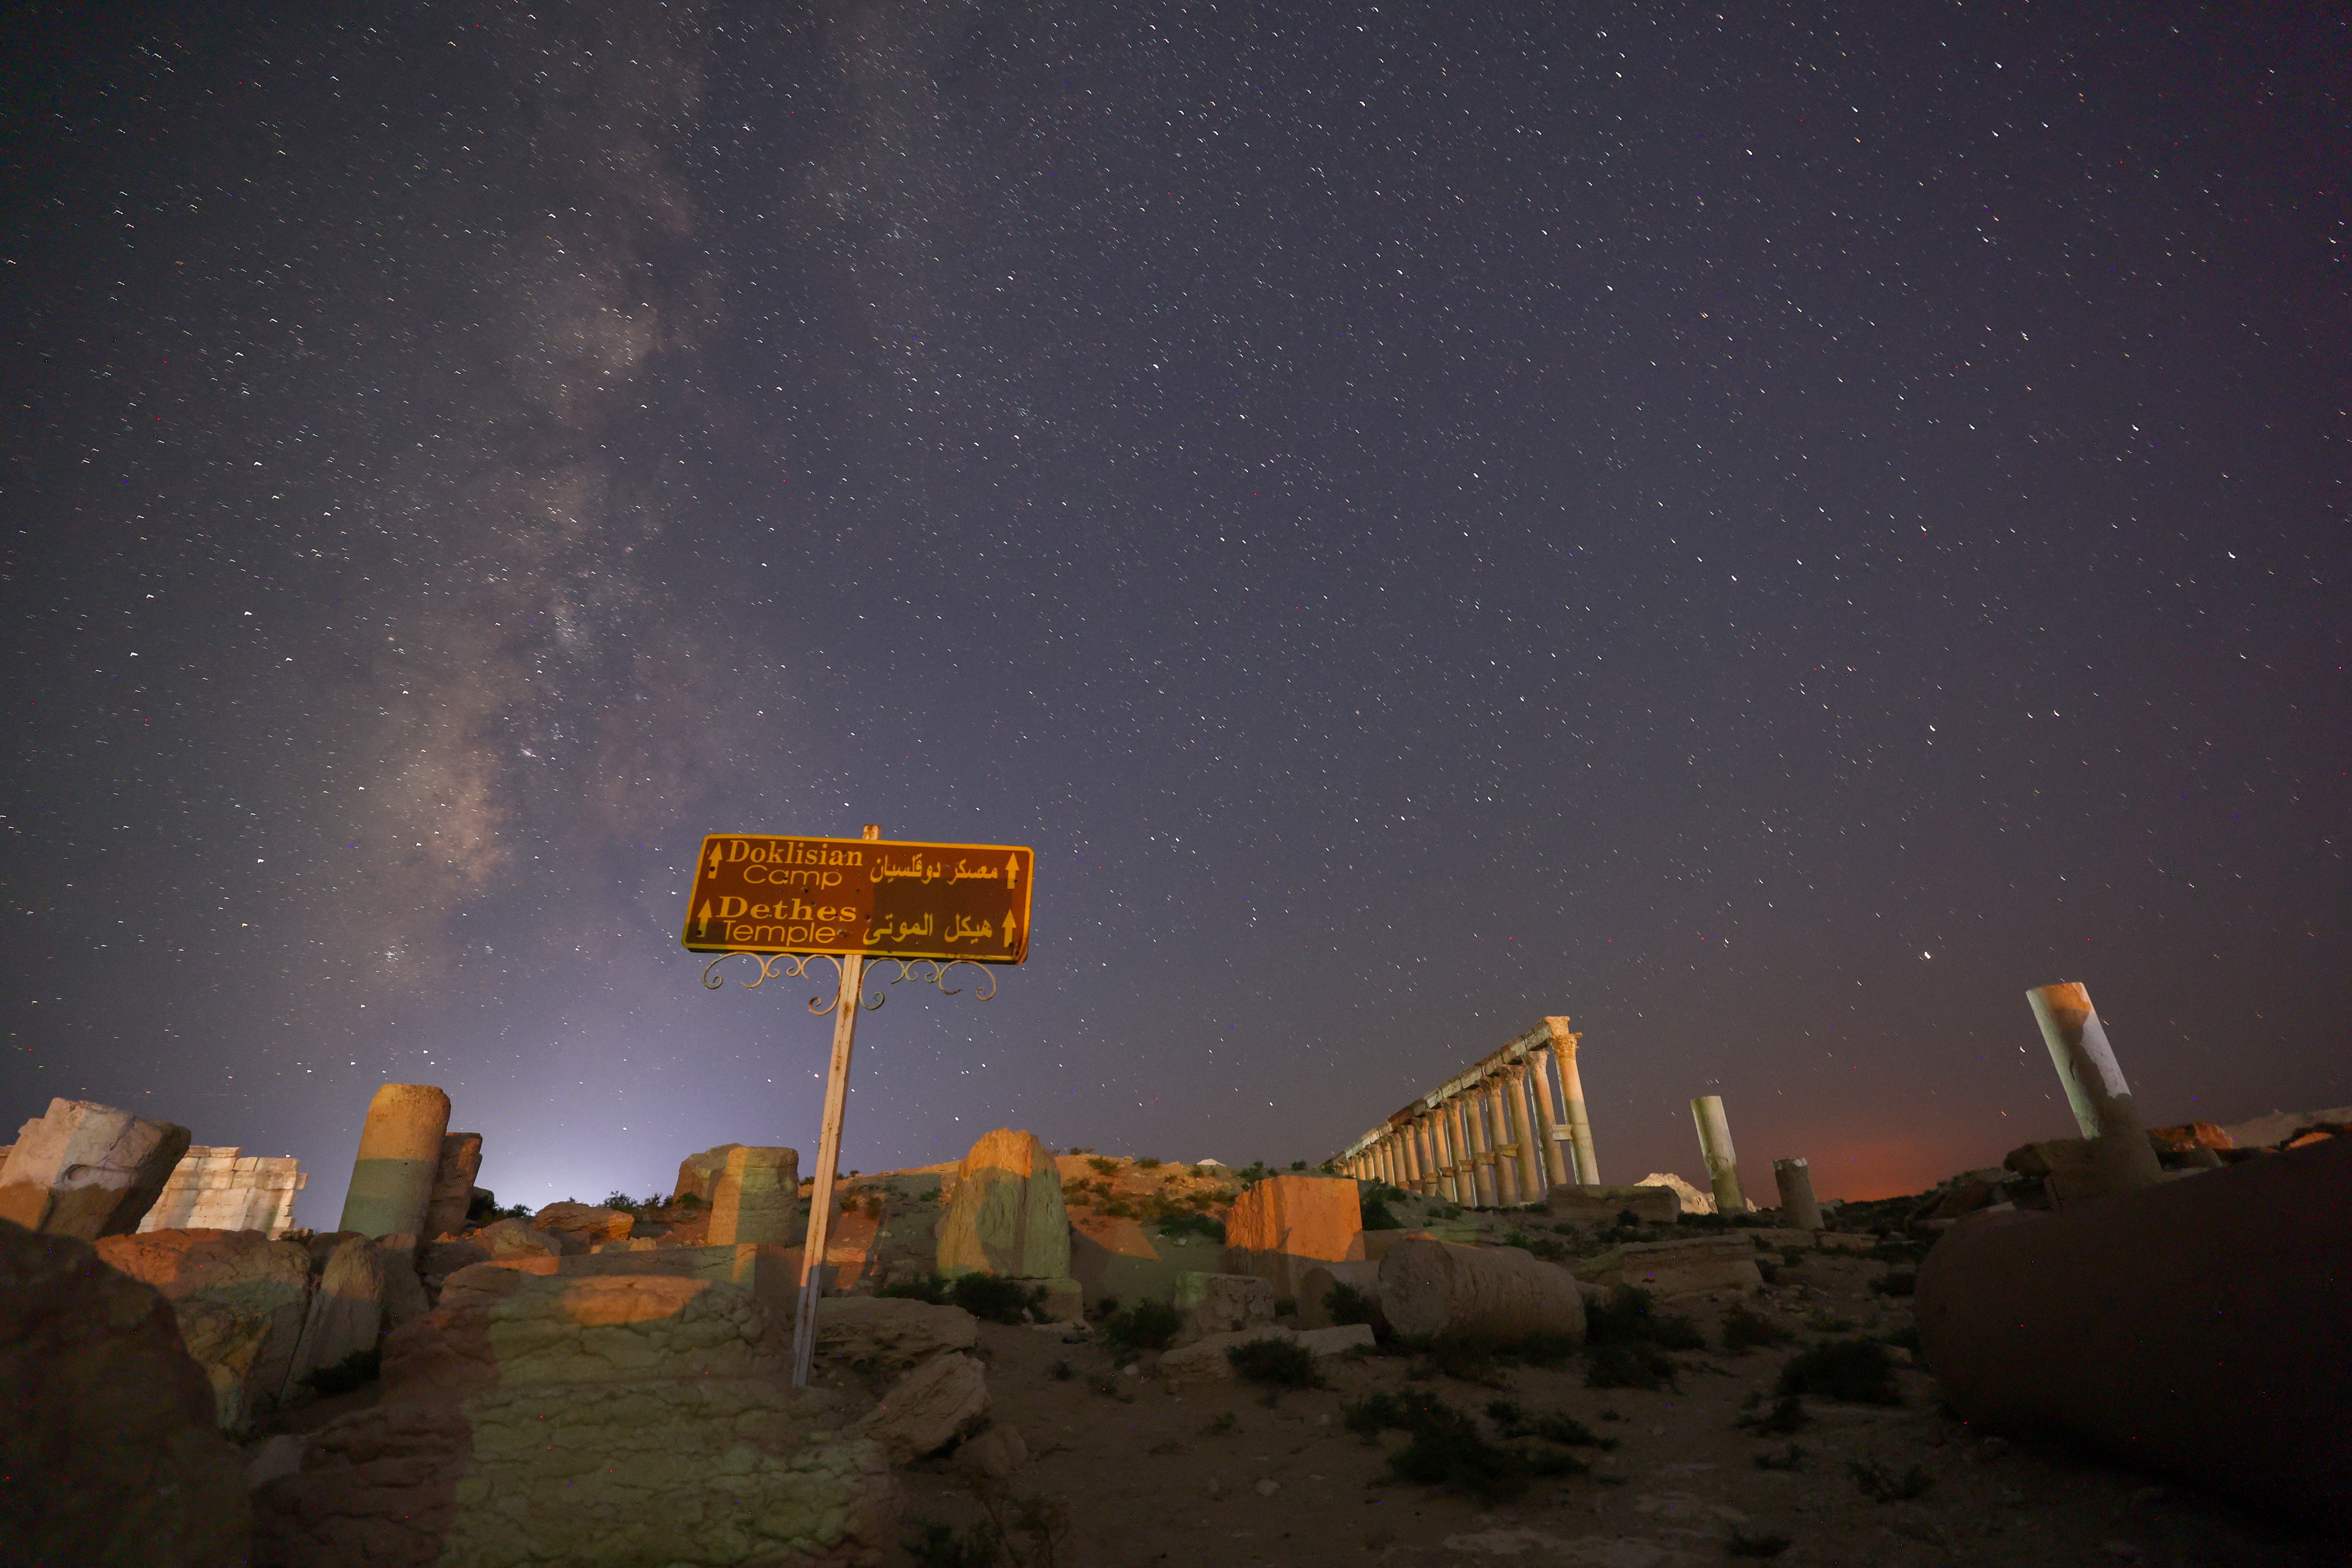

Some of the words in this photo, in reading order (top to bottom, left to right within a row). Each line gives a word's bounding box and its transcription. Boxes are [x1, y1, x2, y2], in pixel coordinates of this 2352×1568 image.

[726, 840, 862, 866] Doklisian
[744, 865, 842, 890] Camp
[870, 853, 940, 884] دوقلسيان
[946, 858, 998, 885] معسكر
[716, 896, 856, 922] Dethes
[723, 920, 835, 946] Temple
[863, 912, 933, 945] الموتى
[944, 914, 992, 944] هيكل
